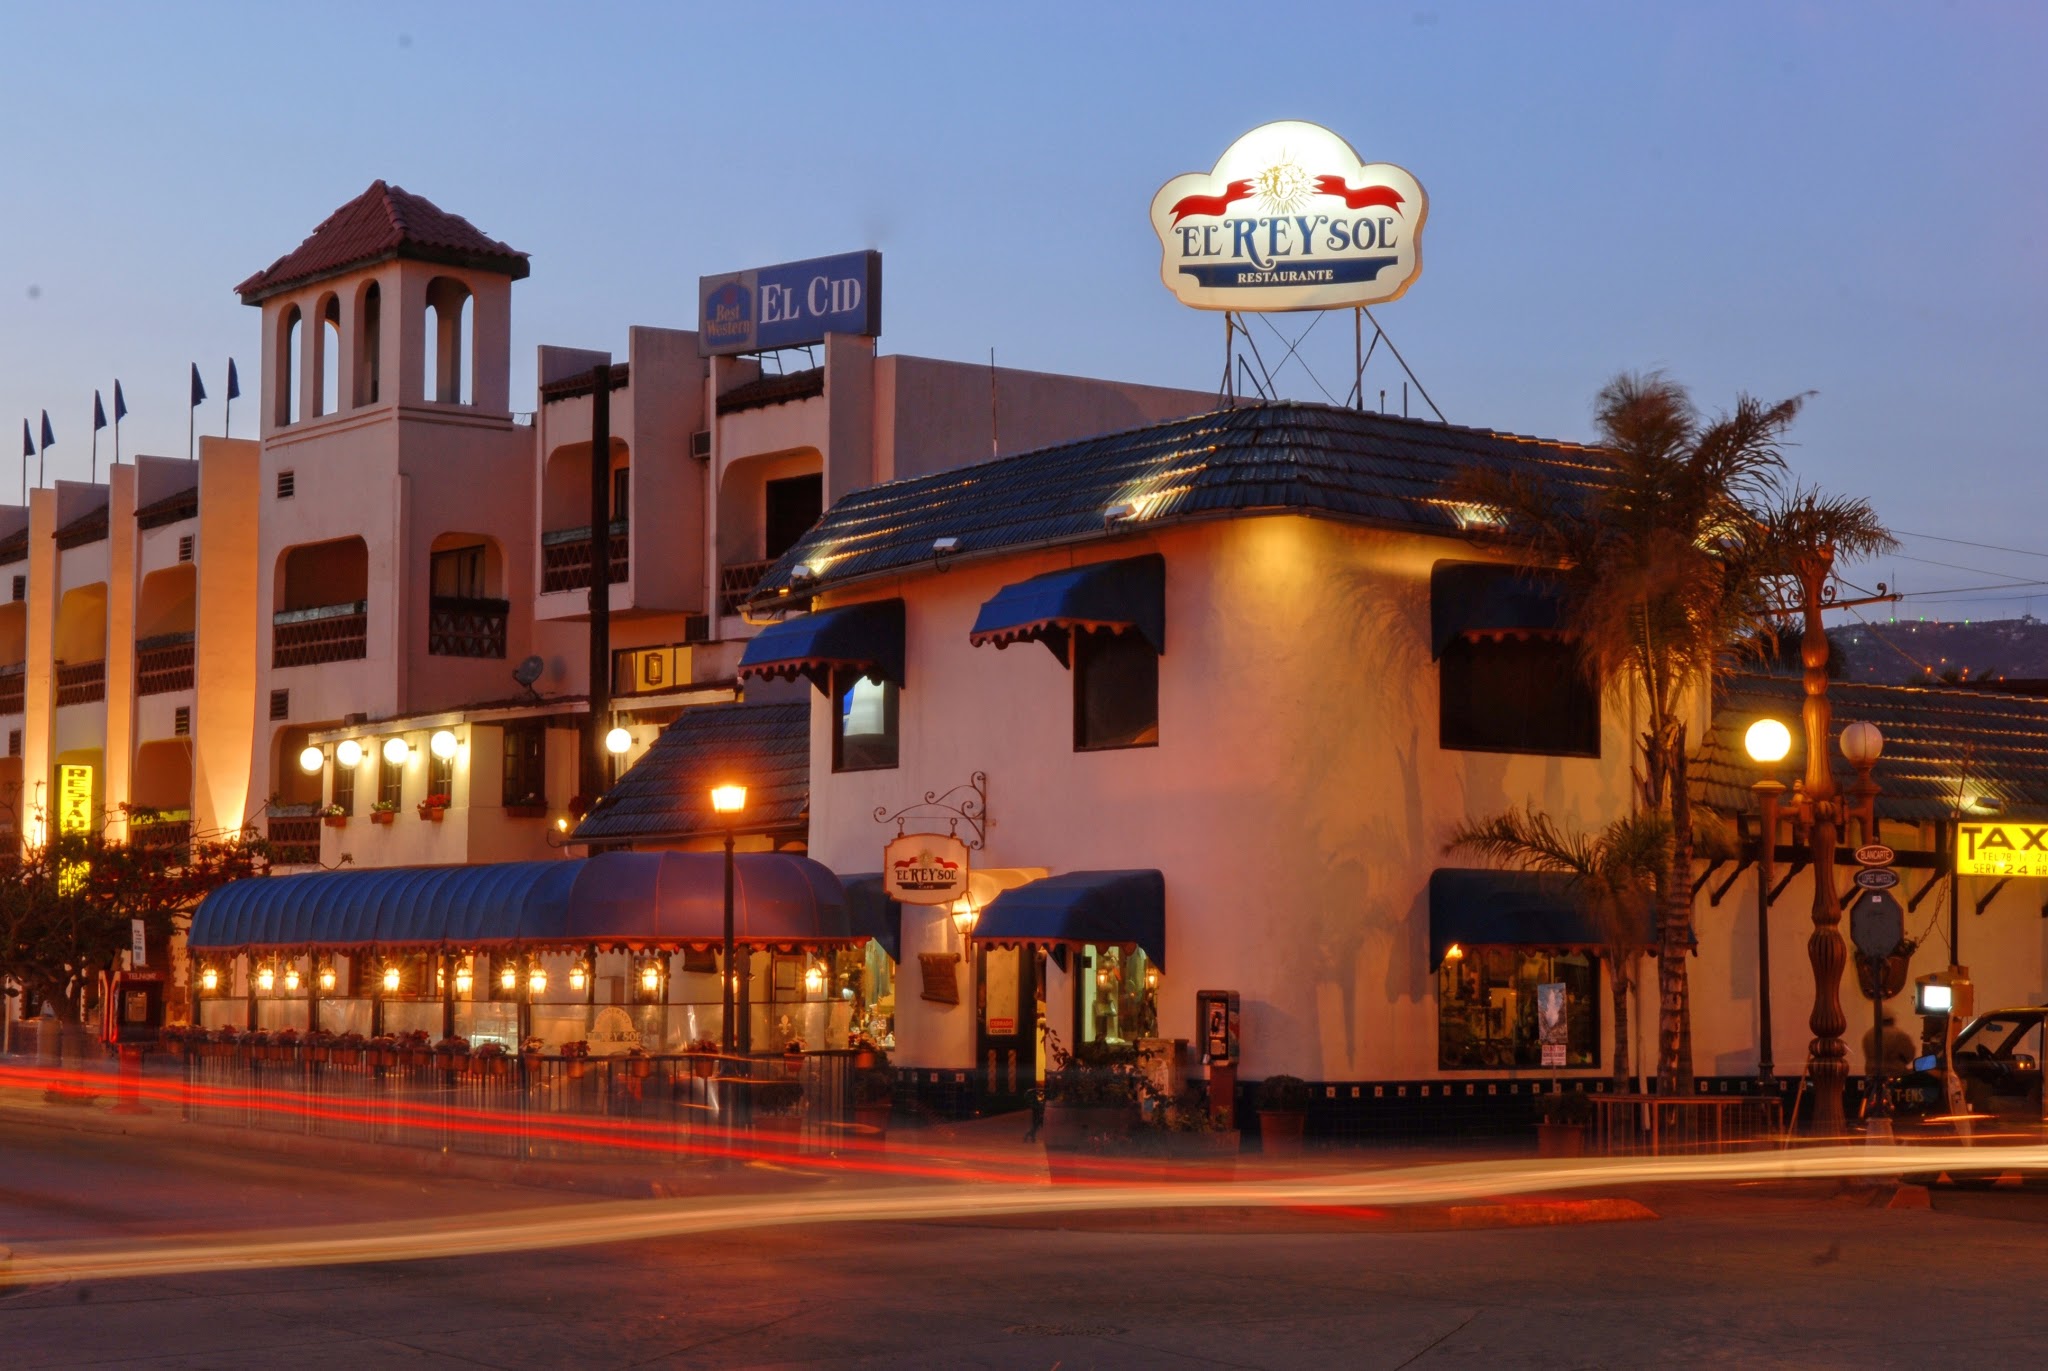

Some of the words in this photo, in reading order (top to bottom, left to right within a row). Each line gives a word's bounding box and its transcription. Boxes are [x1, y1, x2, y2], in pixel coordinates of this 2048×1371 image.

[1175, 225, 1223, 257] EL
[1224, 215, 1329, 270] REY
[1326, 216, 1398, 251] SOL
[1237, 269, 1333, 284] RESTAURANTE
[760, 284, 799, 323] EL
[807, 276, 861, 317] CID
[716, 304, 739, 322] Best
[706, 319, 751, 337] Western
[1860, 850, 1890, 860] BLANCARTE
[895, 870, 908, 880] EL
[909, 868, 937, 885] REY
[937, 870, 956, 880] SOL
[2004, 864, 2028, 874] 24
